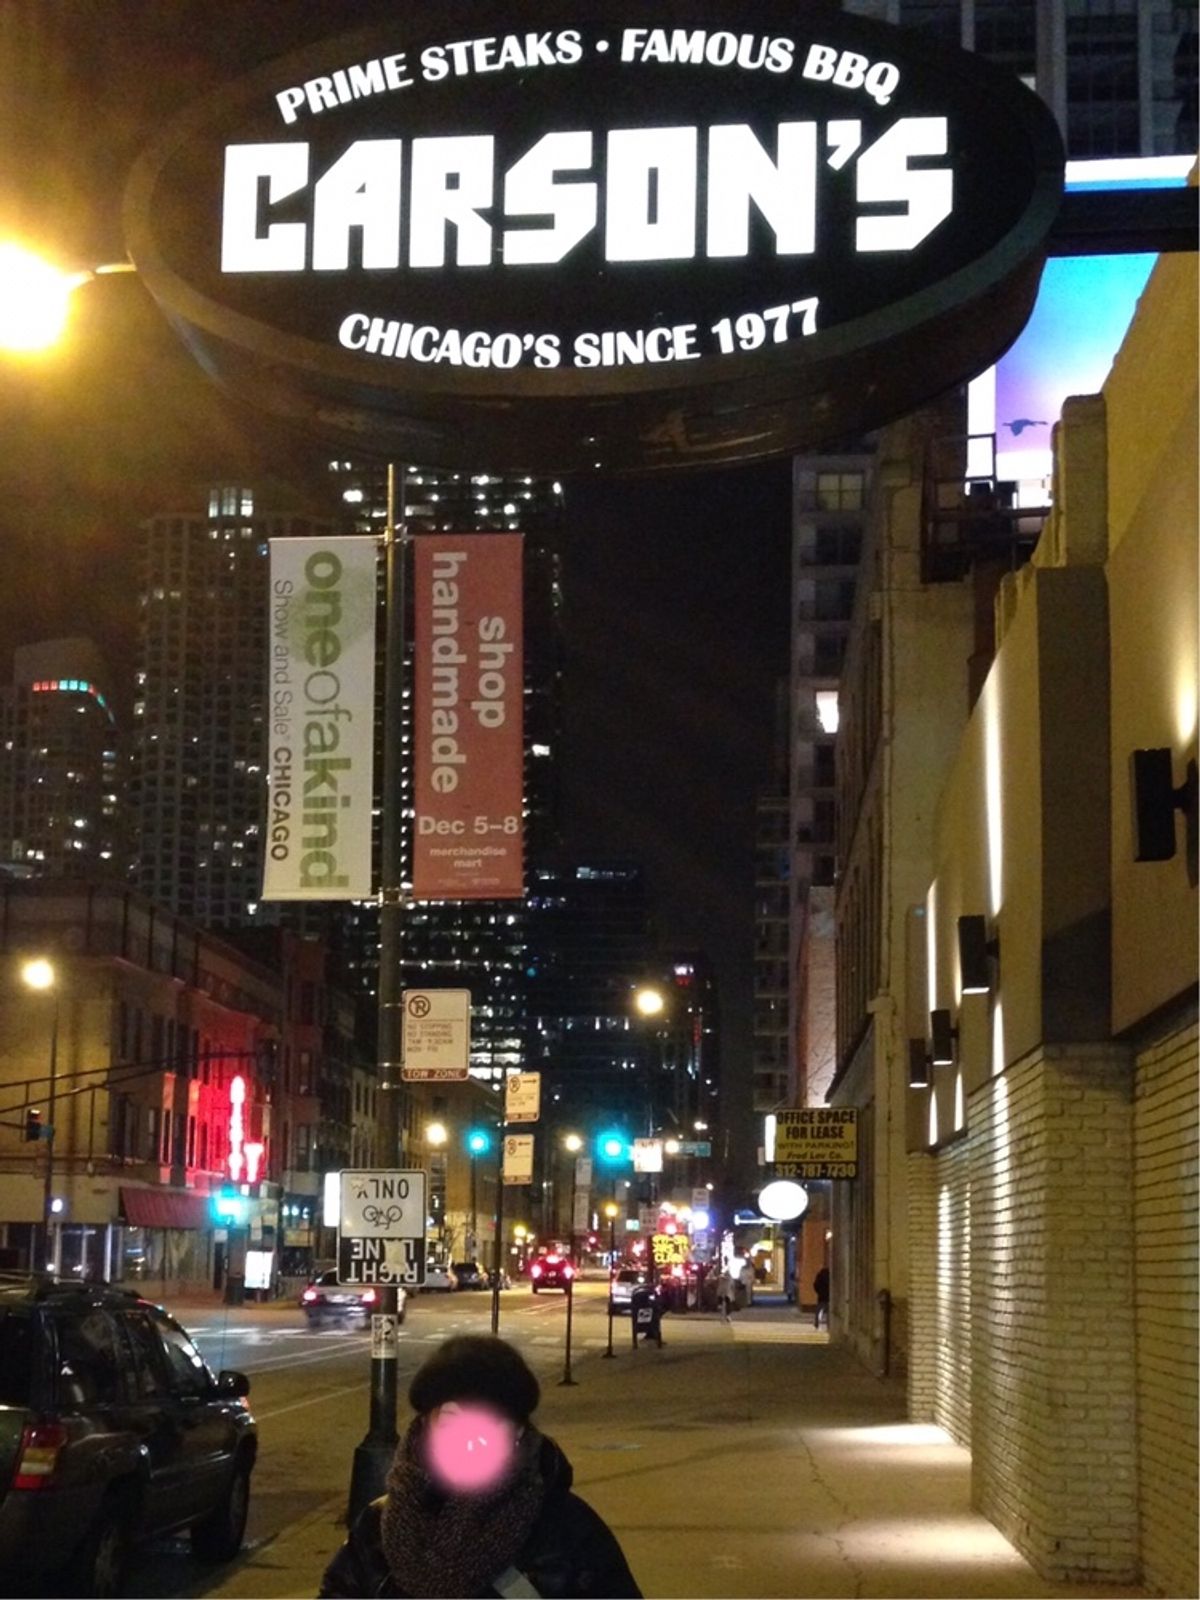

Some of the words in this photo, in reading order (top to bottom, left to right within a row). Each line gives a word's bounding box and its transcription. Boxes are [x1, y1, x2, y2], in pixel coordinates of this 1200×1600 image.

[276, 54, 413, 124] PRIME
[421, 31, 582, 80] STEAKS
[622, 29, 794, 73] FAMOUS
[803, 45, 899, 105] BBQ
[221, 117, 953, 272] CARSON'S
[339, 314, 560, 368] CHICAGO'S
[574, 324, 700, 367] SINCE
[712, 297, 819, 353] 1977
[274, 579, 293, 641] Show
[274, 646, 292, 684] and
[431, 551, 467, 793] handmade
[470, 615, 513, 728] shop
[270, 746, 292, 861] CHICAGO
[419, 816, 465, 834] Dec
[430, 846, 506, 856] merchandise
[454, 859, 482, 867] mart
[407, 1070, 428, 1078] TOW
[434, 1070, 462, 1078] ZONE
[777, 1111, 814, 1124] OFFICE
[817, 1111, 855, 1123] SPACE
[786, 1126, 808, 1139] FOR
[811, 1126, 844, 1139] LEASE
[351, 1239, 414, 1260] LNE
